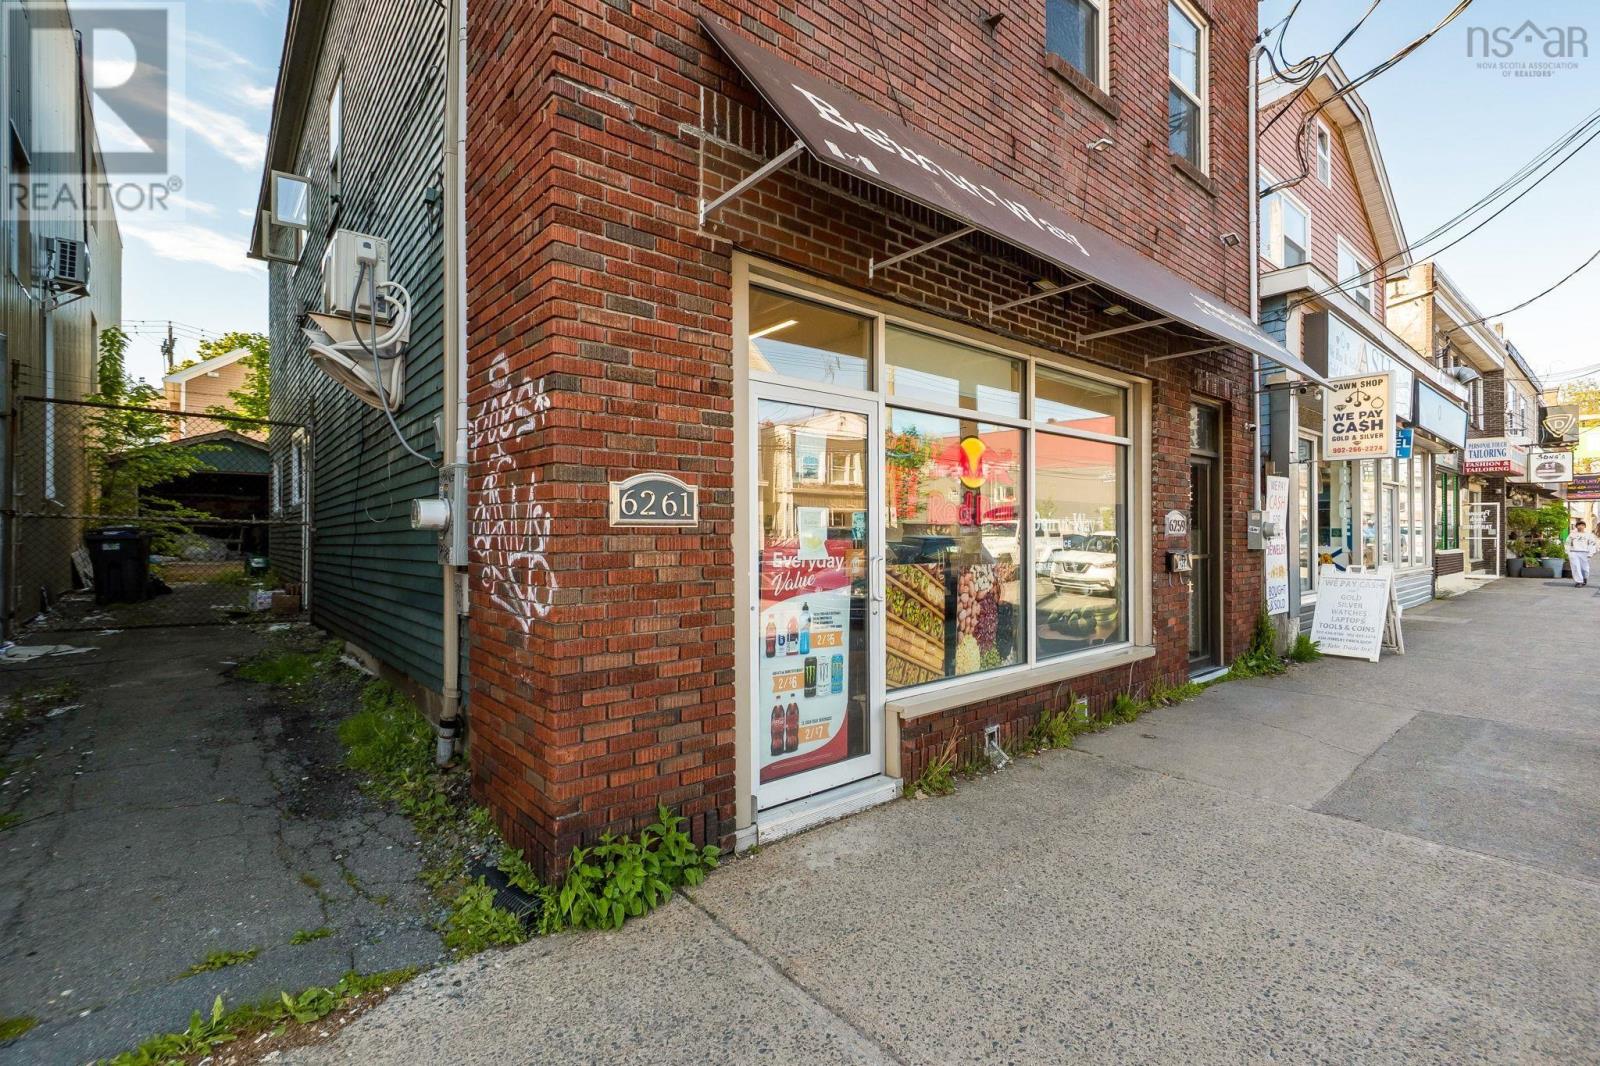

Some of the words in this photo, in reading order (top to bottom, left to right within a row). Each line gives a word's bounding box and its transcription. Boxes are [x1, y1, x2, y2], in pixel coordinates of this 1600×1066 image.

[791, 83, 997, 207] Beirut
[980, 184, 1091, 257] Way
[1360, 379, 1384, 388] SHOP
[1333, 412, 1355, 421] WE
[1359, 410, 1383, 419] PAY
[1469, 448, 1507, 458] TAILORING
[621, 489, 692, 517] 6261
[1169, 520, 1185, 532] 6259
[772, 551, 845, 572] Everyday
[771, 570, 817, 596] Value
[1331, 616, 1366, 624] LAPTOPS
